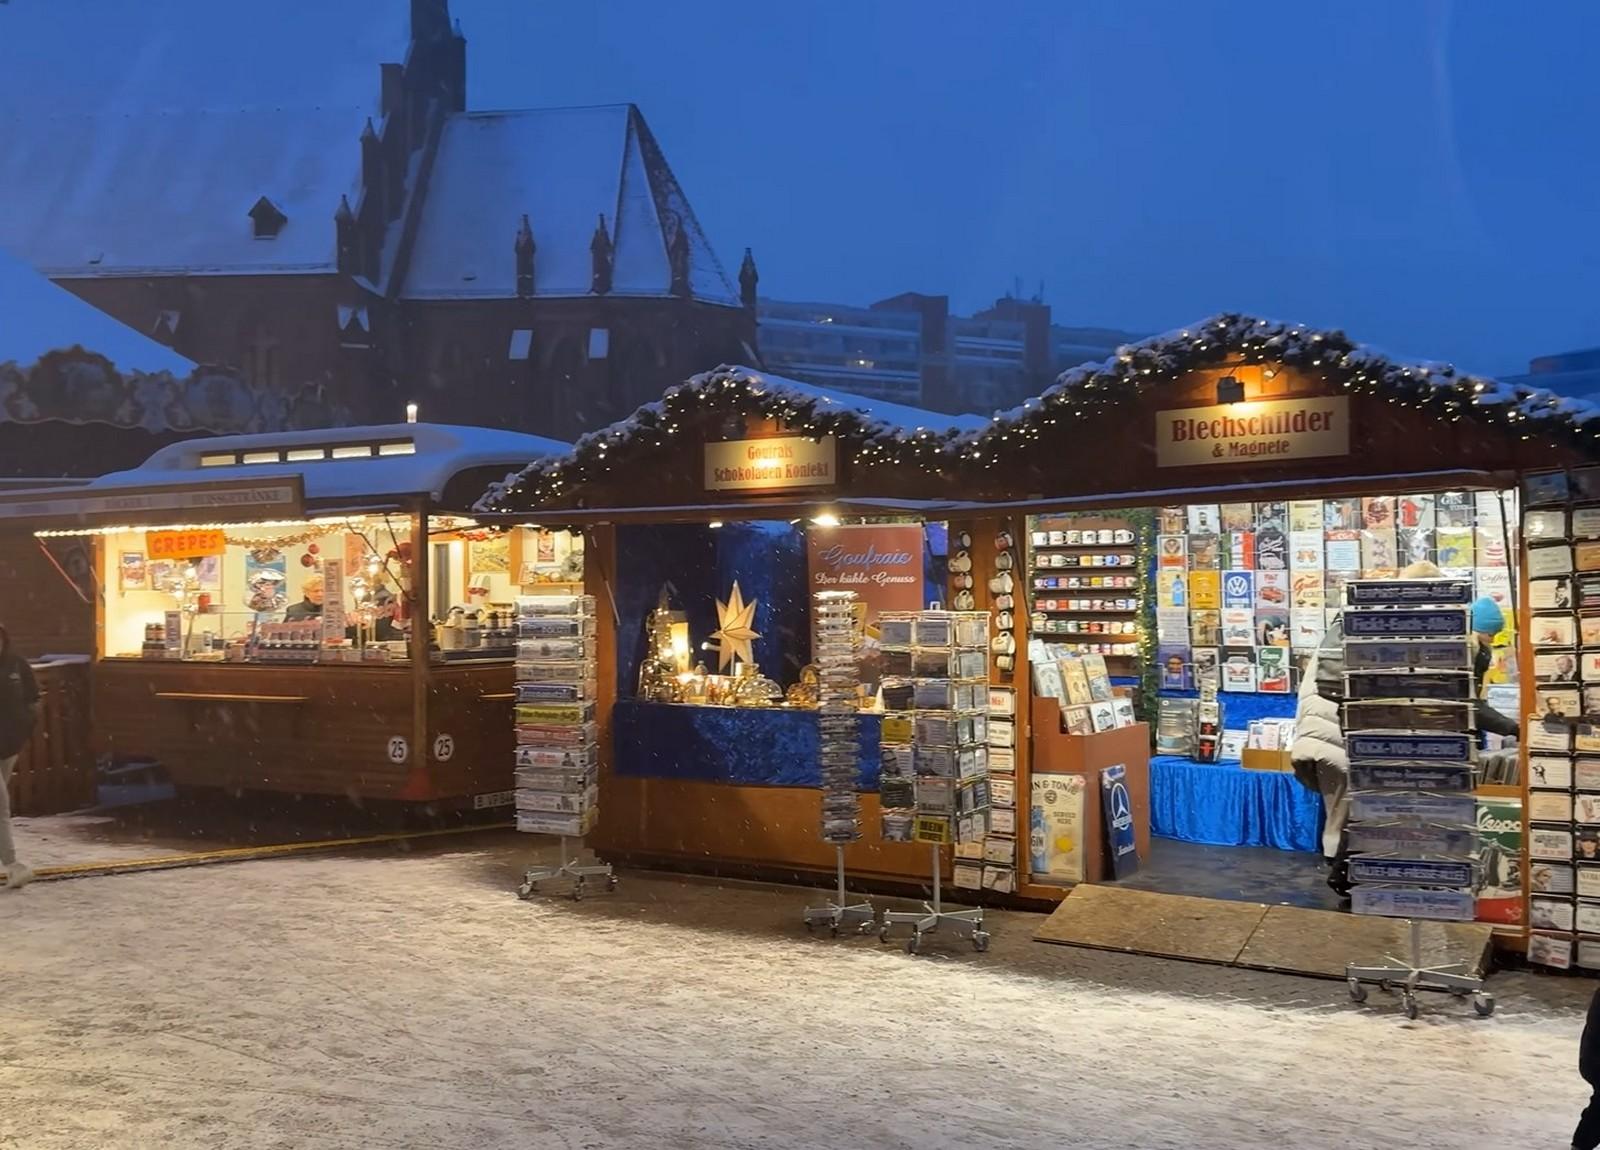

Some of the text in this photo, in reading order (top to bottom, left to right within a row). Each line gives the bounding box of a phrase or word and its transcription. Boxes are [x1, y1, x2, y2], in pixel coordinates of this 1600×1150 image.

[1171, 410, 1334, 442] Blechschilder
[1212, 439, 1290, 458] & Magnete
[714, 465, 782, 482] Schokoladen
[152, 534, 218, 554] CREPES
[815, 571, 917, 587] Der kühle Genuss
[391, 741, 404, 758] 25
[438, 738, 451, 757] 25
